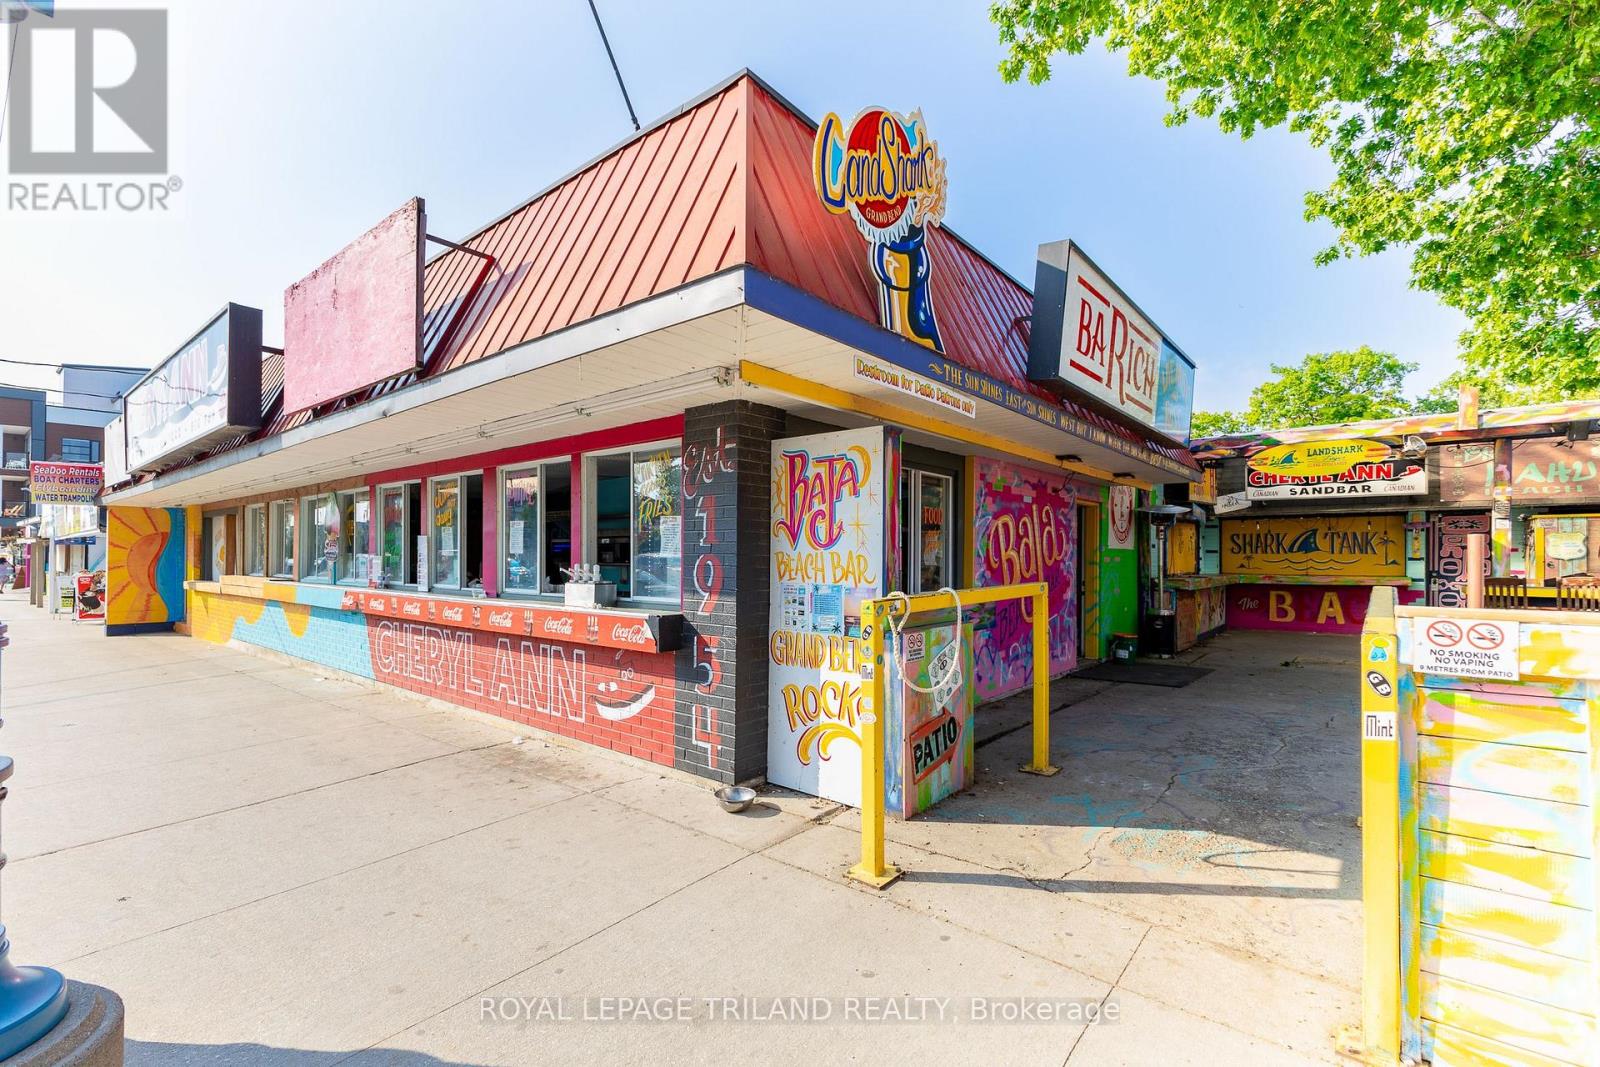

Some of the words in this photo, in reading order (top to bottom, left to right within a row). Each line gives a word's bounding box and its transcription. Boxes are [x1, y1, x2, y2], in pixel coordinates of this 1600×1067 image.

[865, 206, 888, 223] GRAND
[886, 204, 902, 222] BEND
[900, 373, 914, 392] for
[944, 364, 963, 389] THE
[965, 373, 979, 392] SUN
[980, 376, 1003, 402] SHINES
[1006, 390, 1021, 410] EAST
[1306, 444, 1364, 458] LANDSHARK
[34, 465, 67, 475] SeaDoo
[68, 466, 100, 477] Rentals
[34, 475, 56, 483] BOAT
[58, 476, 100, 485] CHARTERS
[1336, 463, 1394, 482] ANN
[35, 493, 59, 502] WATER
[60, 494, 96, 503] TRAMPOLIN
[1289, 484, 1372, 496] SANDBAR
[923, 506, 944, 525] FOOD
[1230, 532, 1288, 555] SHARK
[1323, 531, 1379, 555] TANK
[774, 550, 826, 583] BEACH
[828, 549, 877, 588] BAR
[1238, 596, 1259, 611] The
[771, 629, 827, 670] GRAND
[828, 635, 862, 675] BEN
[1430, 648, 1446, 657] NO
[1448, 650, 1500, 661] SMOKING
[375, 620, 484, 697] CHERYL
[490, 637, 586, 723] ANN
[1426, 665, 1459, 674] METRES
[1460, 667, 1486, 675] FROM
[1487, 669, 1513, 678] PATIO
[1434, 656, 1451, 665] NO
[1452, 657, 1494, 668] VAPING
[782, 680, 862, 733] ROCK
[1366, 715, 1393, 737] Mint
[912, 716, 958, 774] PATIO
